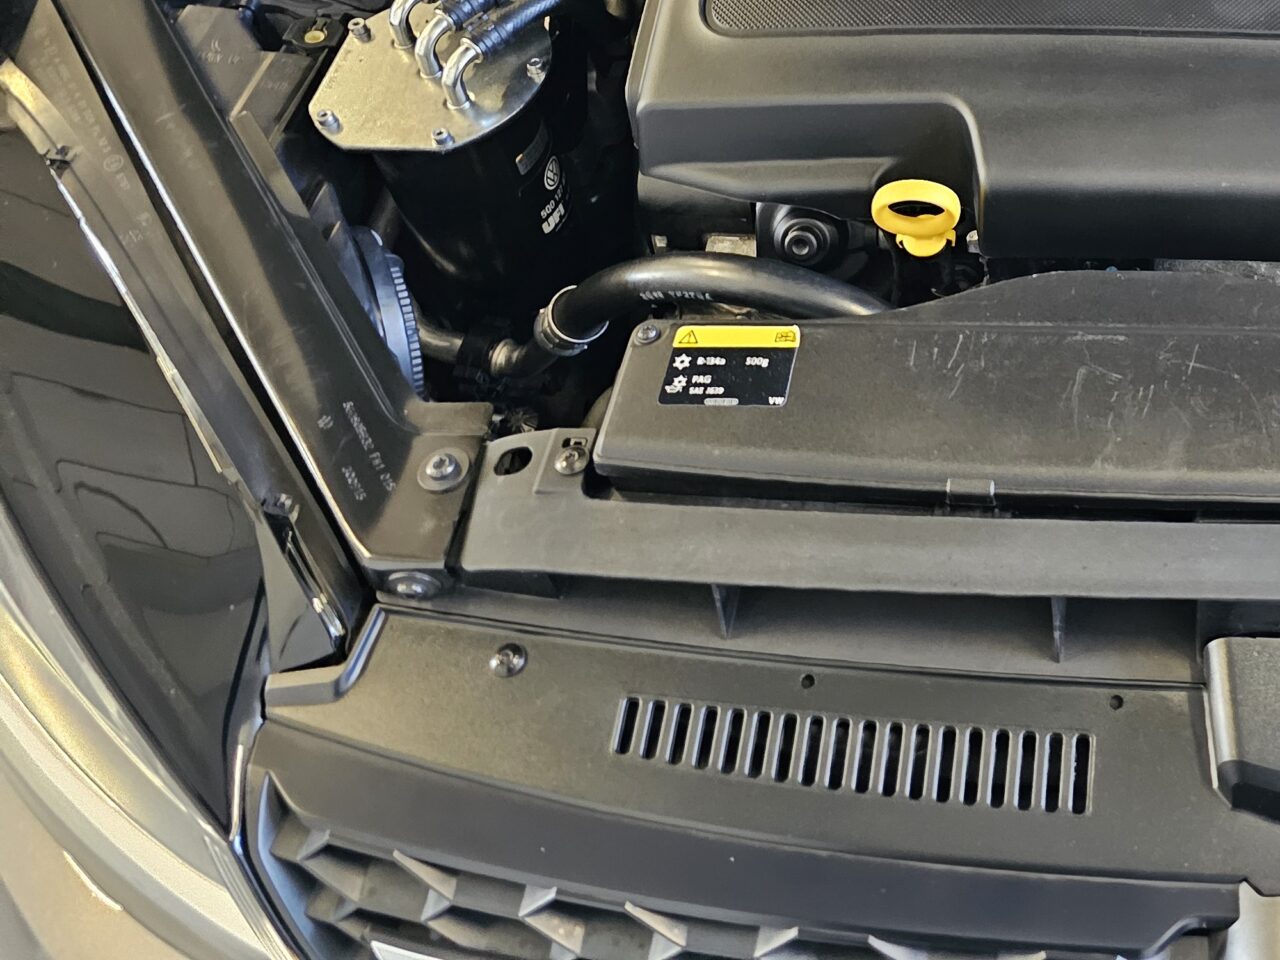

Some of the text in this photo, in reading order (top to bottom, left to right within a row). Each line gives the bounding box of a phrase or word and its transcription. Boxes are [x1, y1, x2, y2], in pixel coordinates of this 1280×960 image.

[542, 203, 565, 234] UFI
[691, 374, 712, 384] PAG
[768, 396, 785, 405] VW
